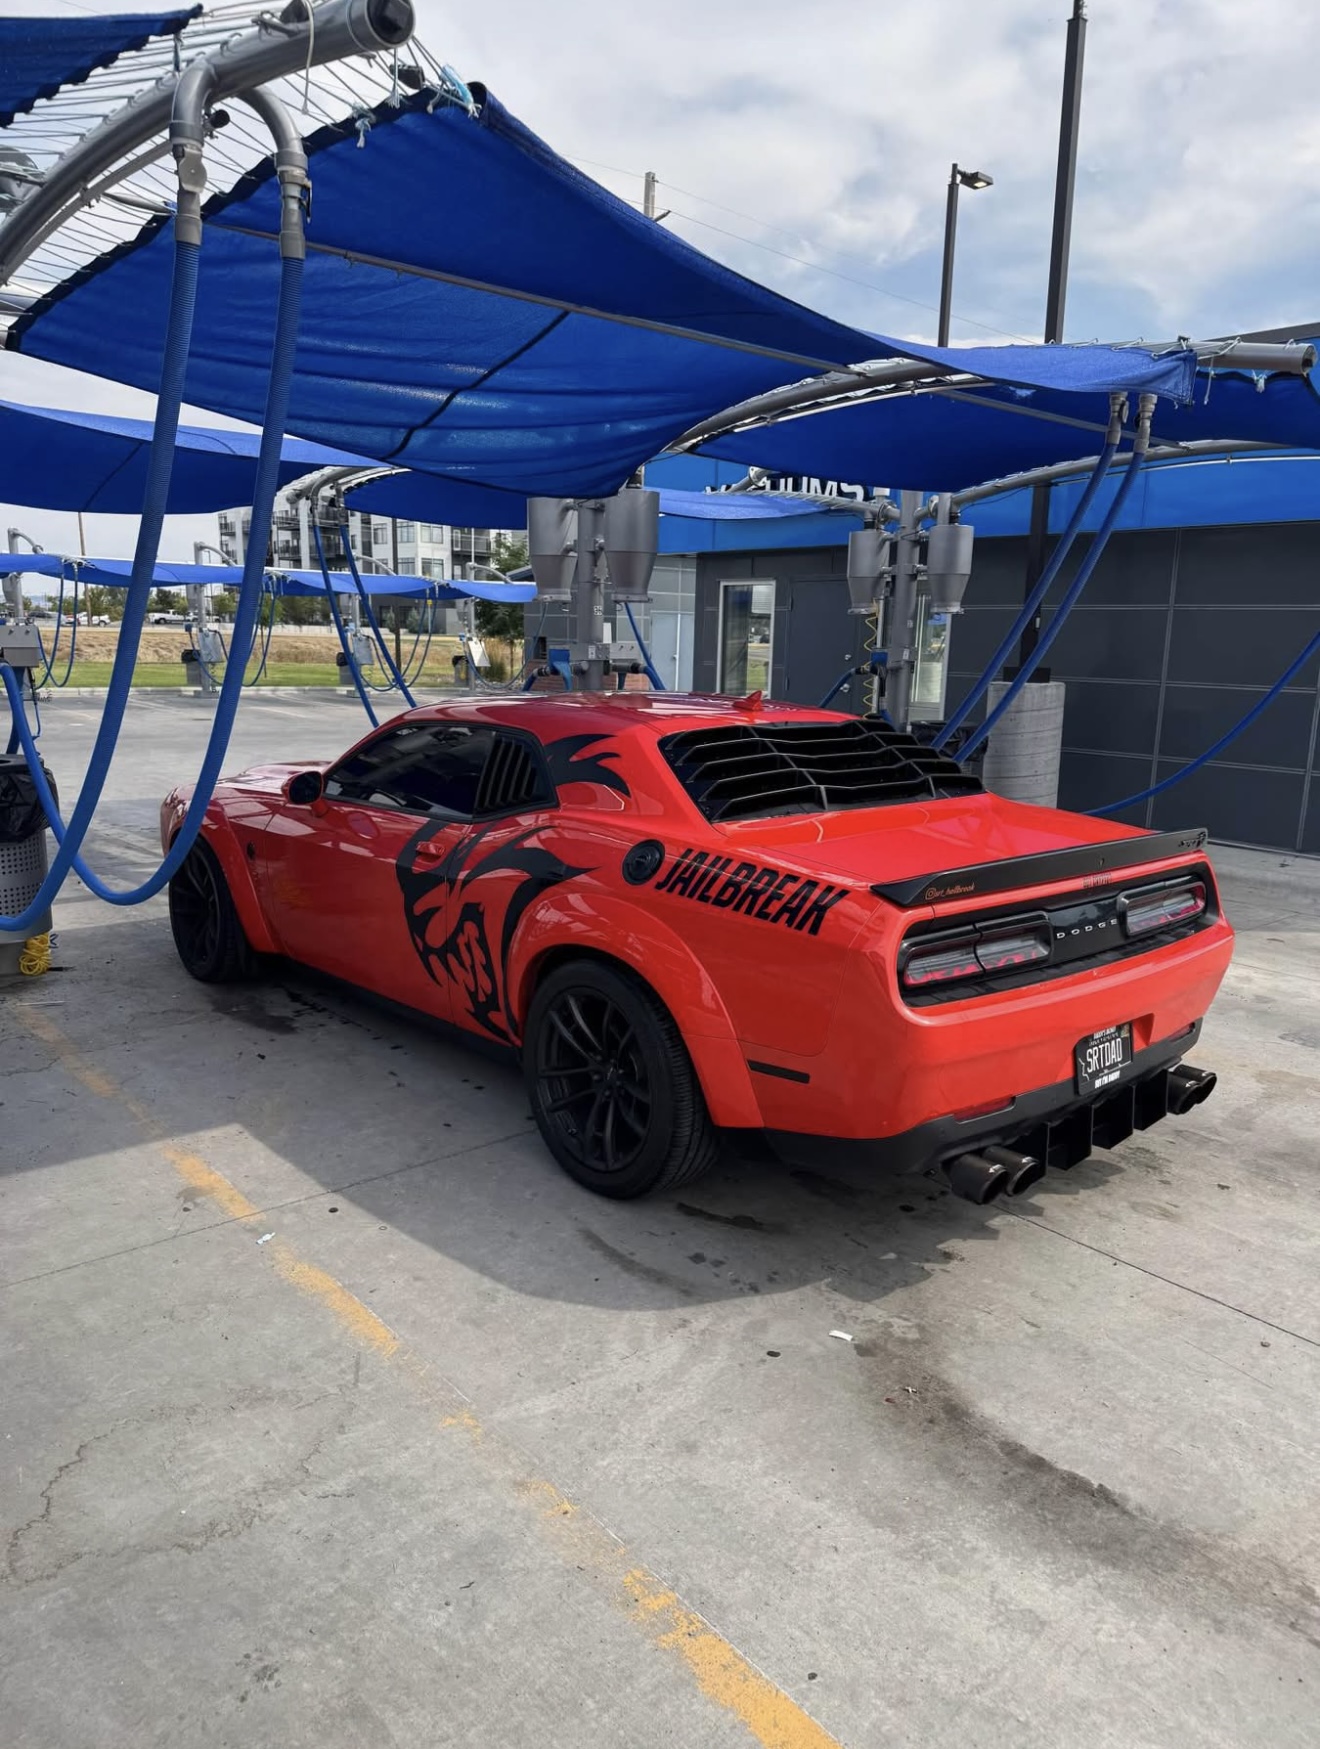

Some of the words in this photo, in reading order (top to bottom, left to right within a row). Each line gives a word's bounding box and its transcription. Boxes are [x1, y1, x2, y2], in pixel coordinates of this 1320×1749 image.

[654, 848, 851, 936] JAILBREAK
[1056, 918, 1118, 939] DODGE
[1086, 1038, 1122, 1073] SRTDAD
